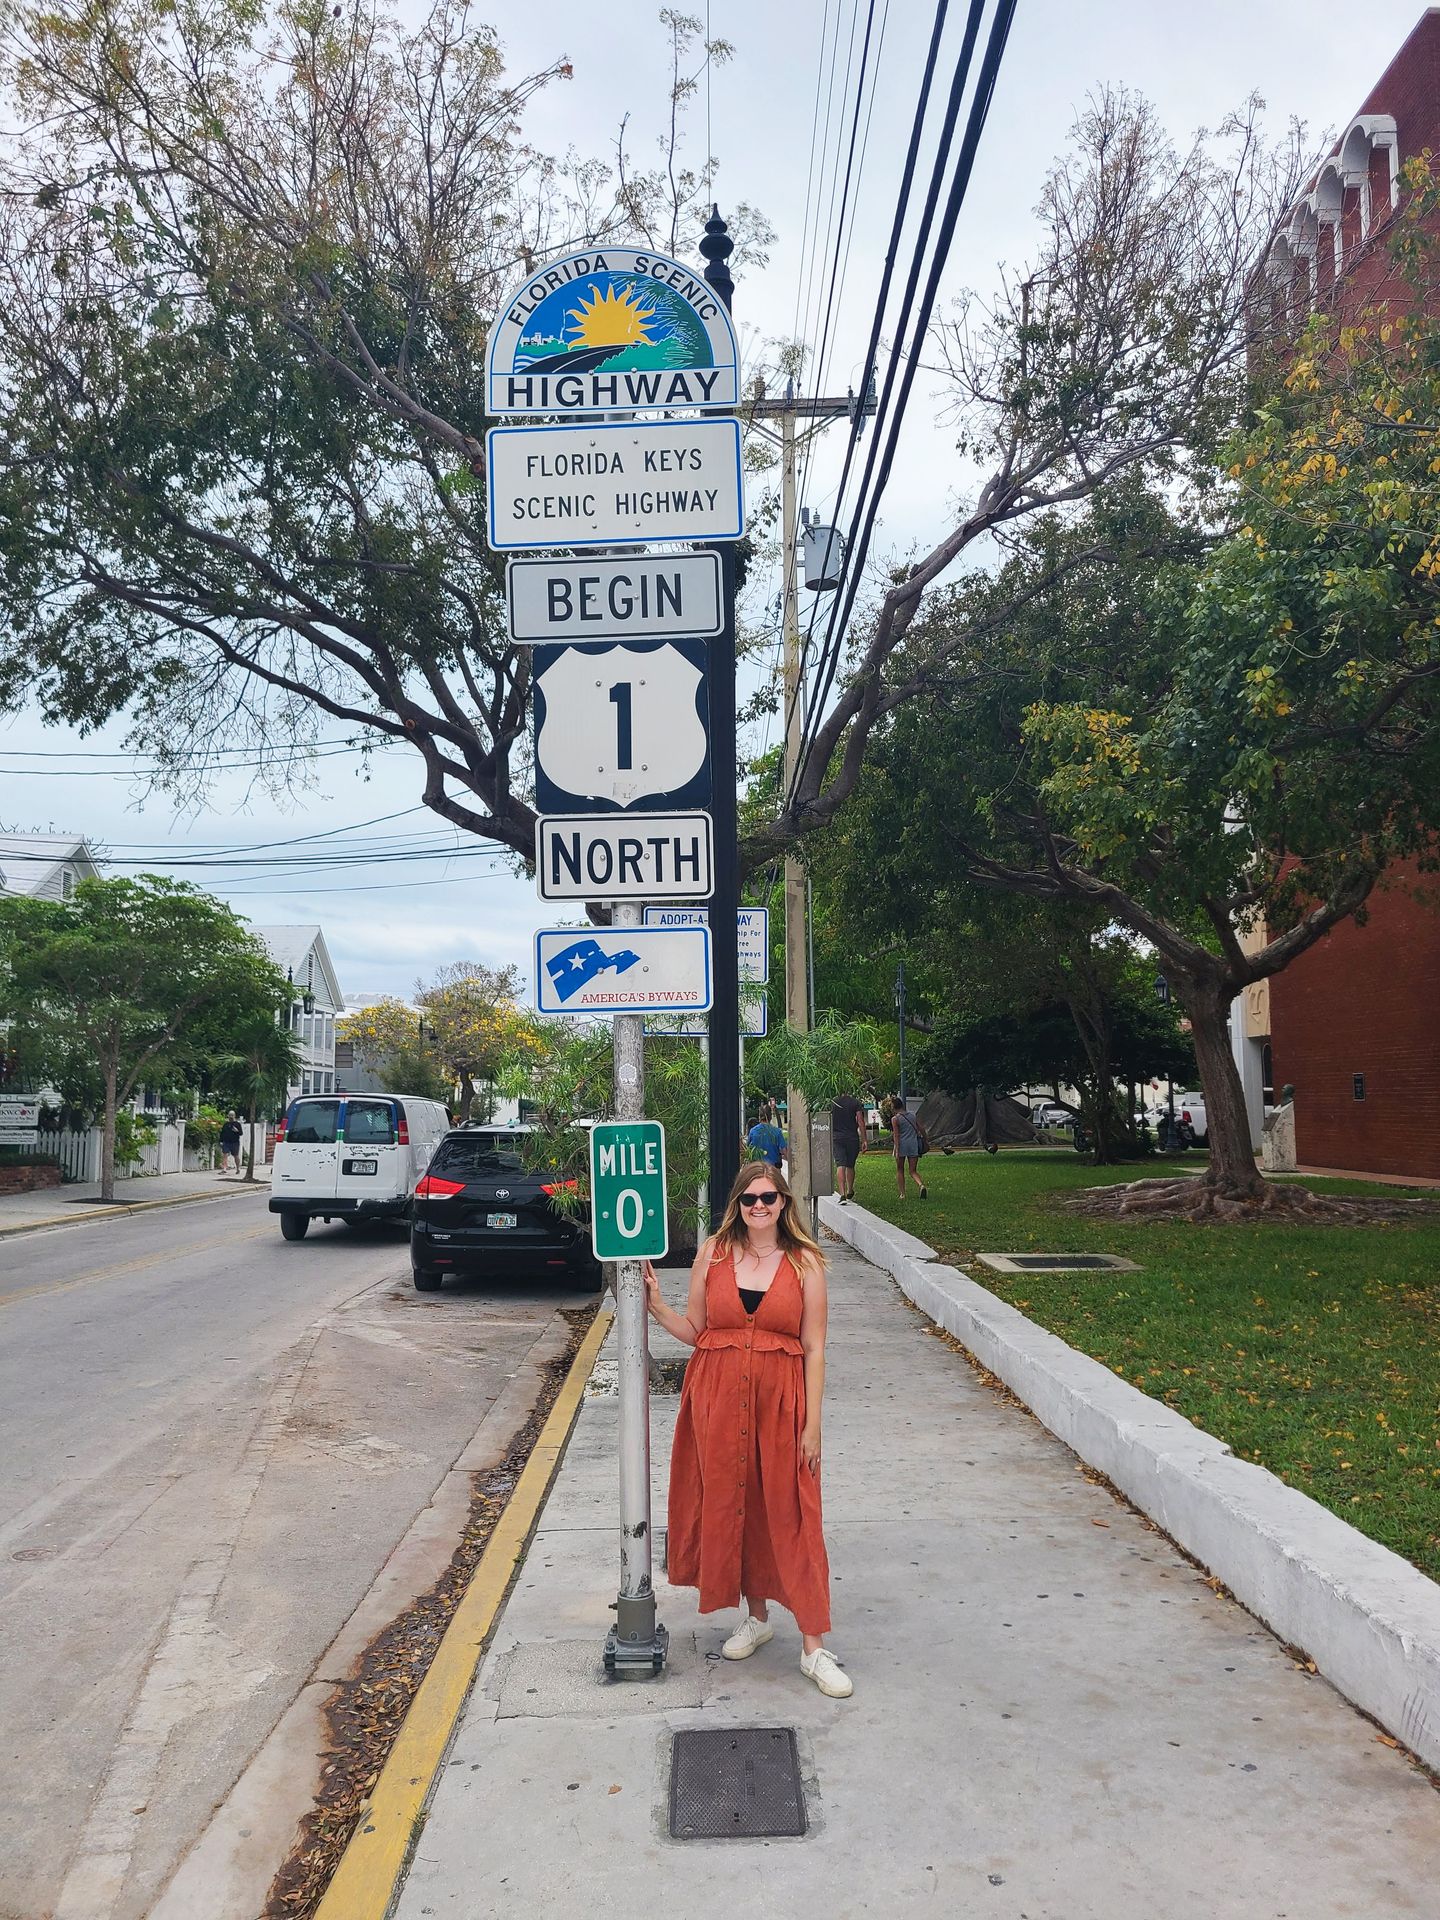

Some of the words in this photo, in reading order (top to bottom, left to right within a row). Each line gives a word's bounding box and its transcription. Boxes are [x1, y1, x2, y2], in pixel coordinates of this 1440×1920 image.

[508, 254, 609, 327] FLORIDA
[633, 256, 718, 321] SCENIC
[507, 371, 720, 407] HIGHWAY
[527, 452, 624, 477] FLORIDA
[644, 448, 702, 472] KEYS
[512, 494, 596, 519] SCENIC
[616, 489, 719, 515] HIGHWAY
[547, 573, 683, 622] BEGIN
[609, 682, 632, 770] 1
[551, 832, 700, 885] NORTH
[581, 992, 645, 1004] AMERICA'S
[648, 991, 698, 1002] BYWAYS
[599, 1142, 658, 1177] MILE
[616, 1188, 643, 1239] 0
